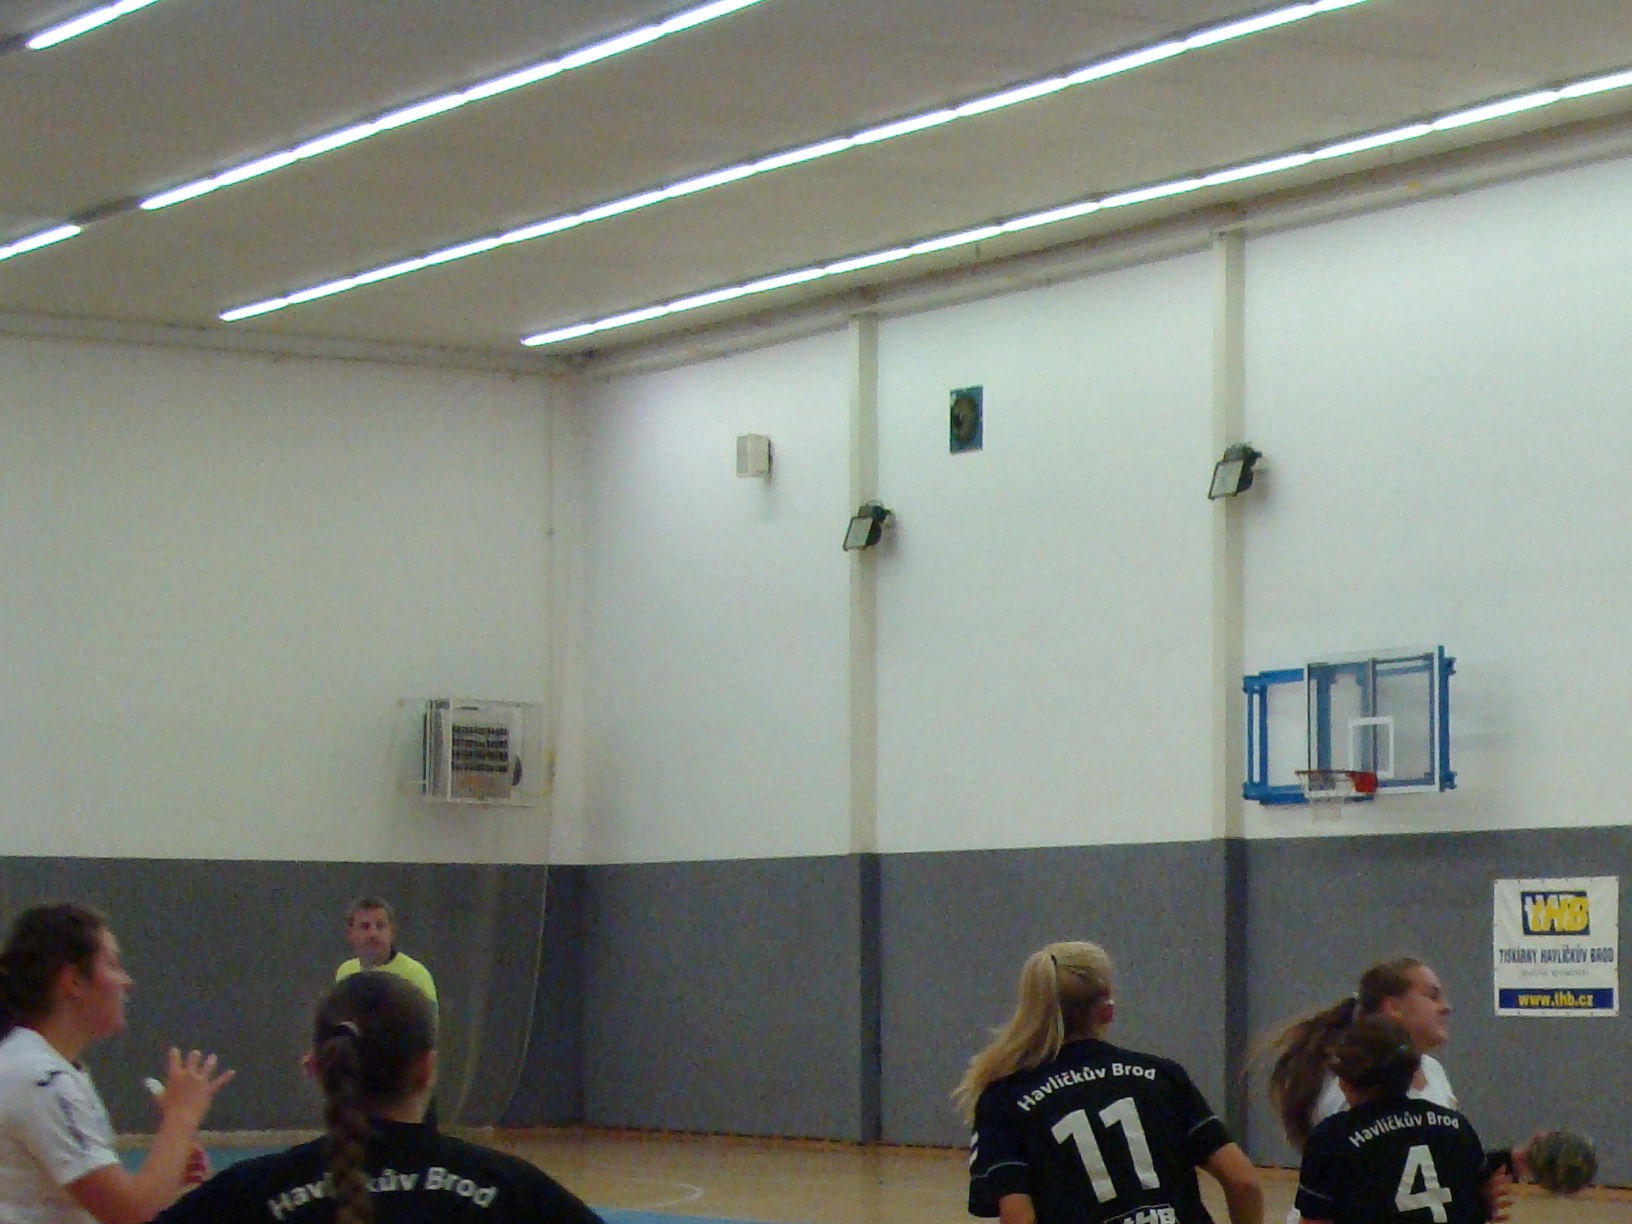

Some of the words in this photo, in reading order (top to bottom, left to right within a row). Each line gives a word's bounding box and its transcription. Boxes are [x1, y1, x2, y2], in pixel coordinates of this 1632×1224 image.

[1517, 991, 1594, 1007] www.thb.cz
[1017, 1066, 1107, 1112] Havlíčkův
[1112, 1062, 1157, 1081] Brod
[1051, 1096, 1161, 1203] 11
[1348, 1110, 1424, 1148] Havlíčkův
[1426, 1111, 1460, 1130] Brod
[424, 1166, 499, 1208] Brod
[1395, 1144, 1453, 1224] 4
